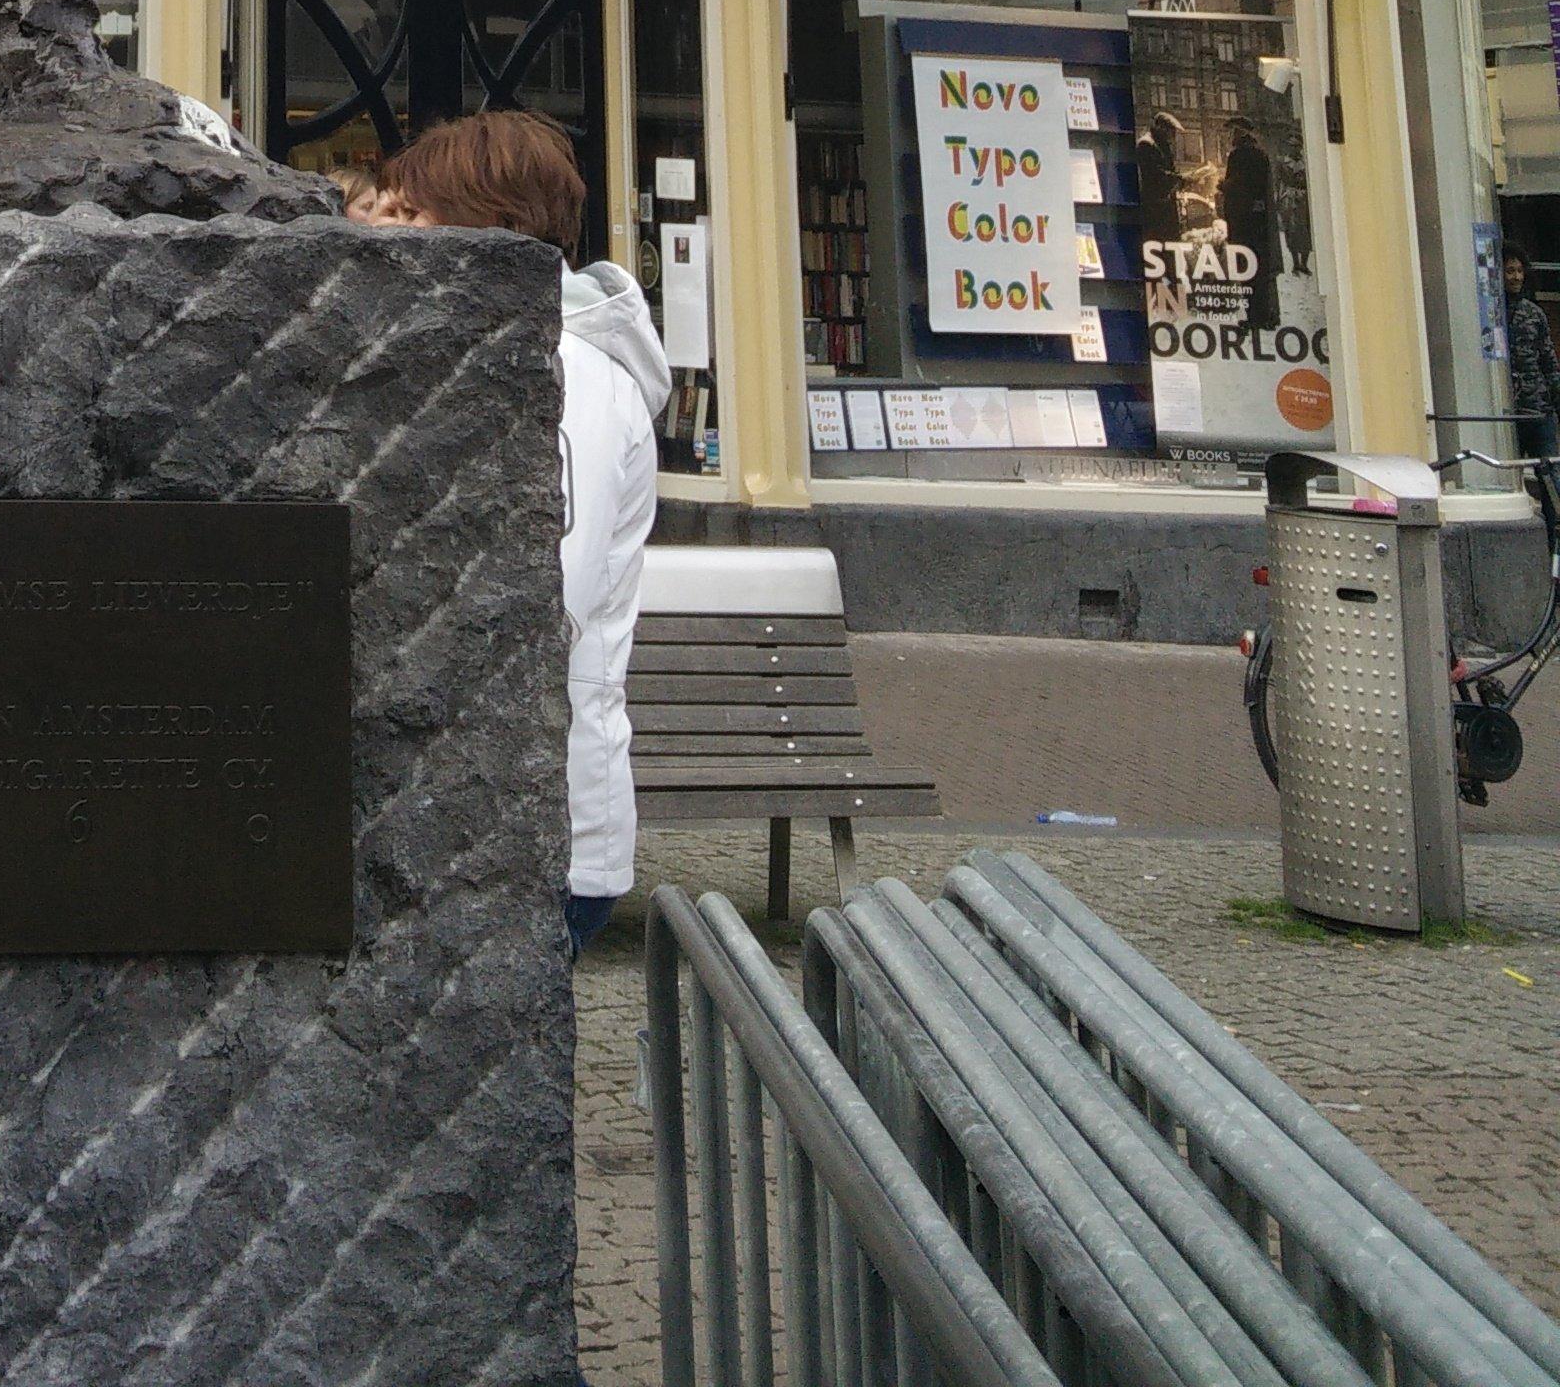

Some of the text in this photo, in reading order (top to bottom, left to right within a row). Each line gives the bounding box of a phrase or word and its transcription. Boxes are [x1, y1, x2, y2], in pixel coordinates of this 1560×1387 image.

[939, 69, 1040, 113] Novo
[944, 135, 1041, 187] Typo
[948, 201, 1049, 243] Color
[1142, 240, 1258, 282] STAD
[955, 269, 1053, 310] Book
[1146, 281, 1187, 323] IN
[1194, 283, 1253, 295] Amsterdam
[1195, 297, 1250, 309] 1940-1945
[1186, 449, 1231, 461] BOOKS
[32, 705, 275, 737] AMSTERDAM
